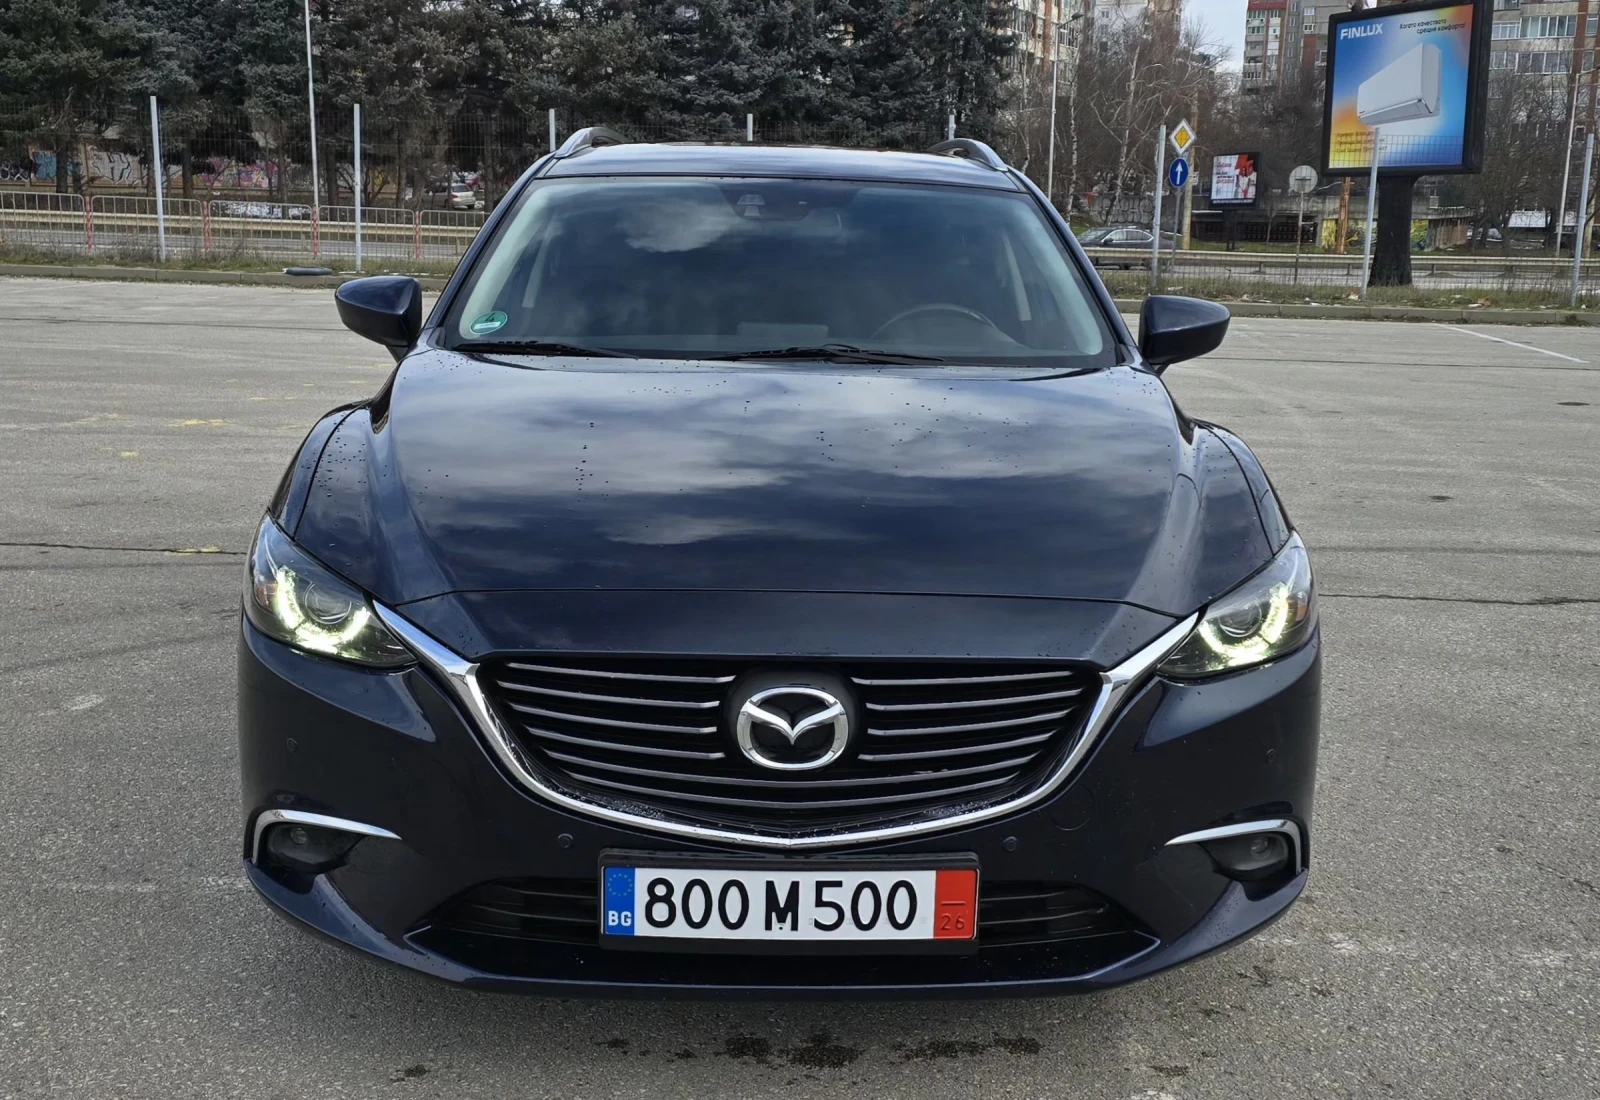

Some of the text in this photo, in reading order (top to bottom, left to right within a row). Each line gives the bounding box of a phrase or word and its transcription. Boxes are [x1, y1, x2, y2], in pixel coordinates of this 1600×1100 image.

[1340, 23, 1384, 40] FINLUX
[645, 877, 918, 932] 800 M 500
[608, 910, 632, 927] BG
[940, 912, 966, 931] 26
